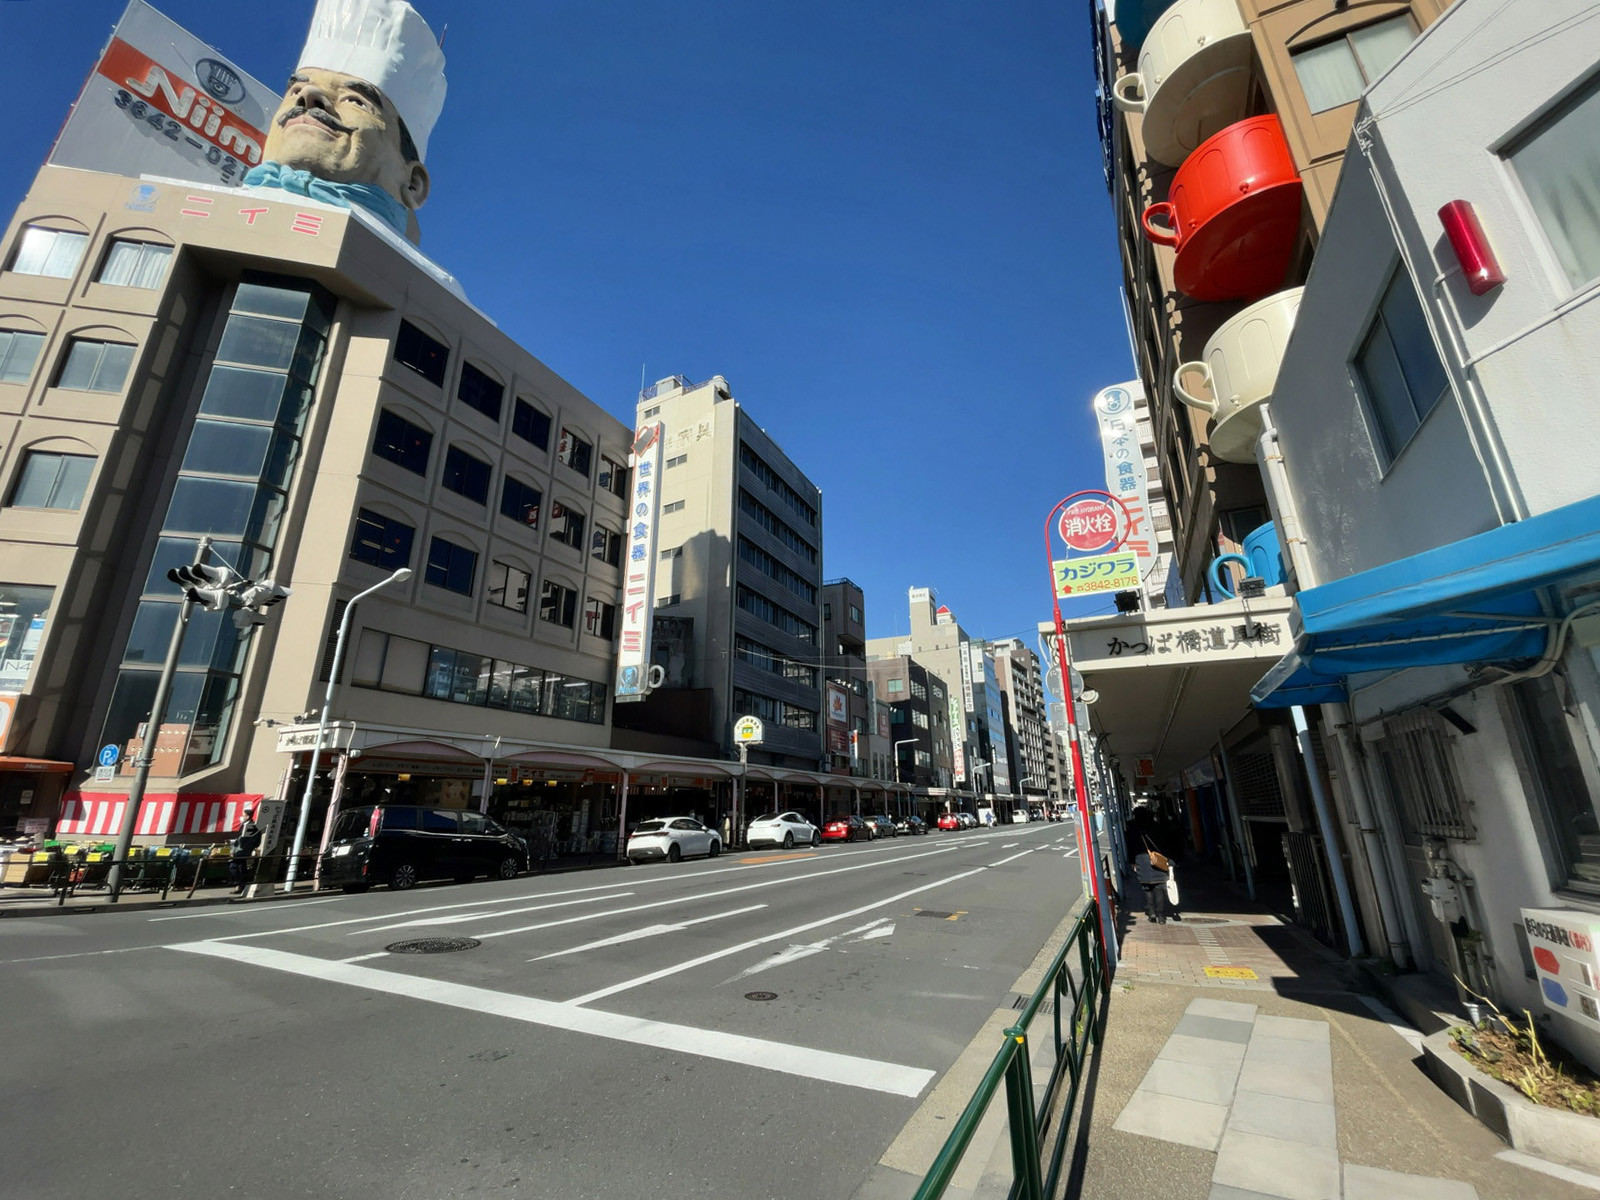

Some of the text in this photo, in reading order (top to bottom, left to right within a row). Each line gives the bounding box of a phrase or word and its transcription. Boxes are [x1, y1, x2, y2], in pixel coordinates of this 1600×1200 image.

[181, 195, 323, 236] ニイミ
[1110, 418, 1137, 492] 日本の食器
[1080, 504, 1105, 514] HYDRANT
[1065, 513, 1113, 537] 消火栓
[622, 460, 653, 652] 世界の食器 ニイミ
[1059, 558, 1135, 582] カジワラ
[1084, 576, 1138, 592] 3842-8176
